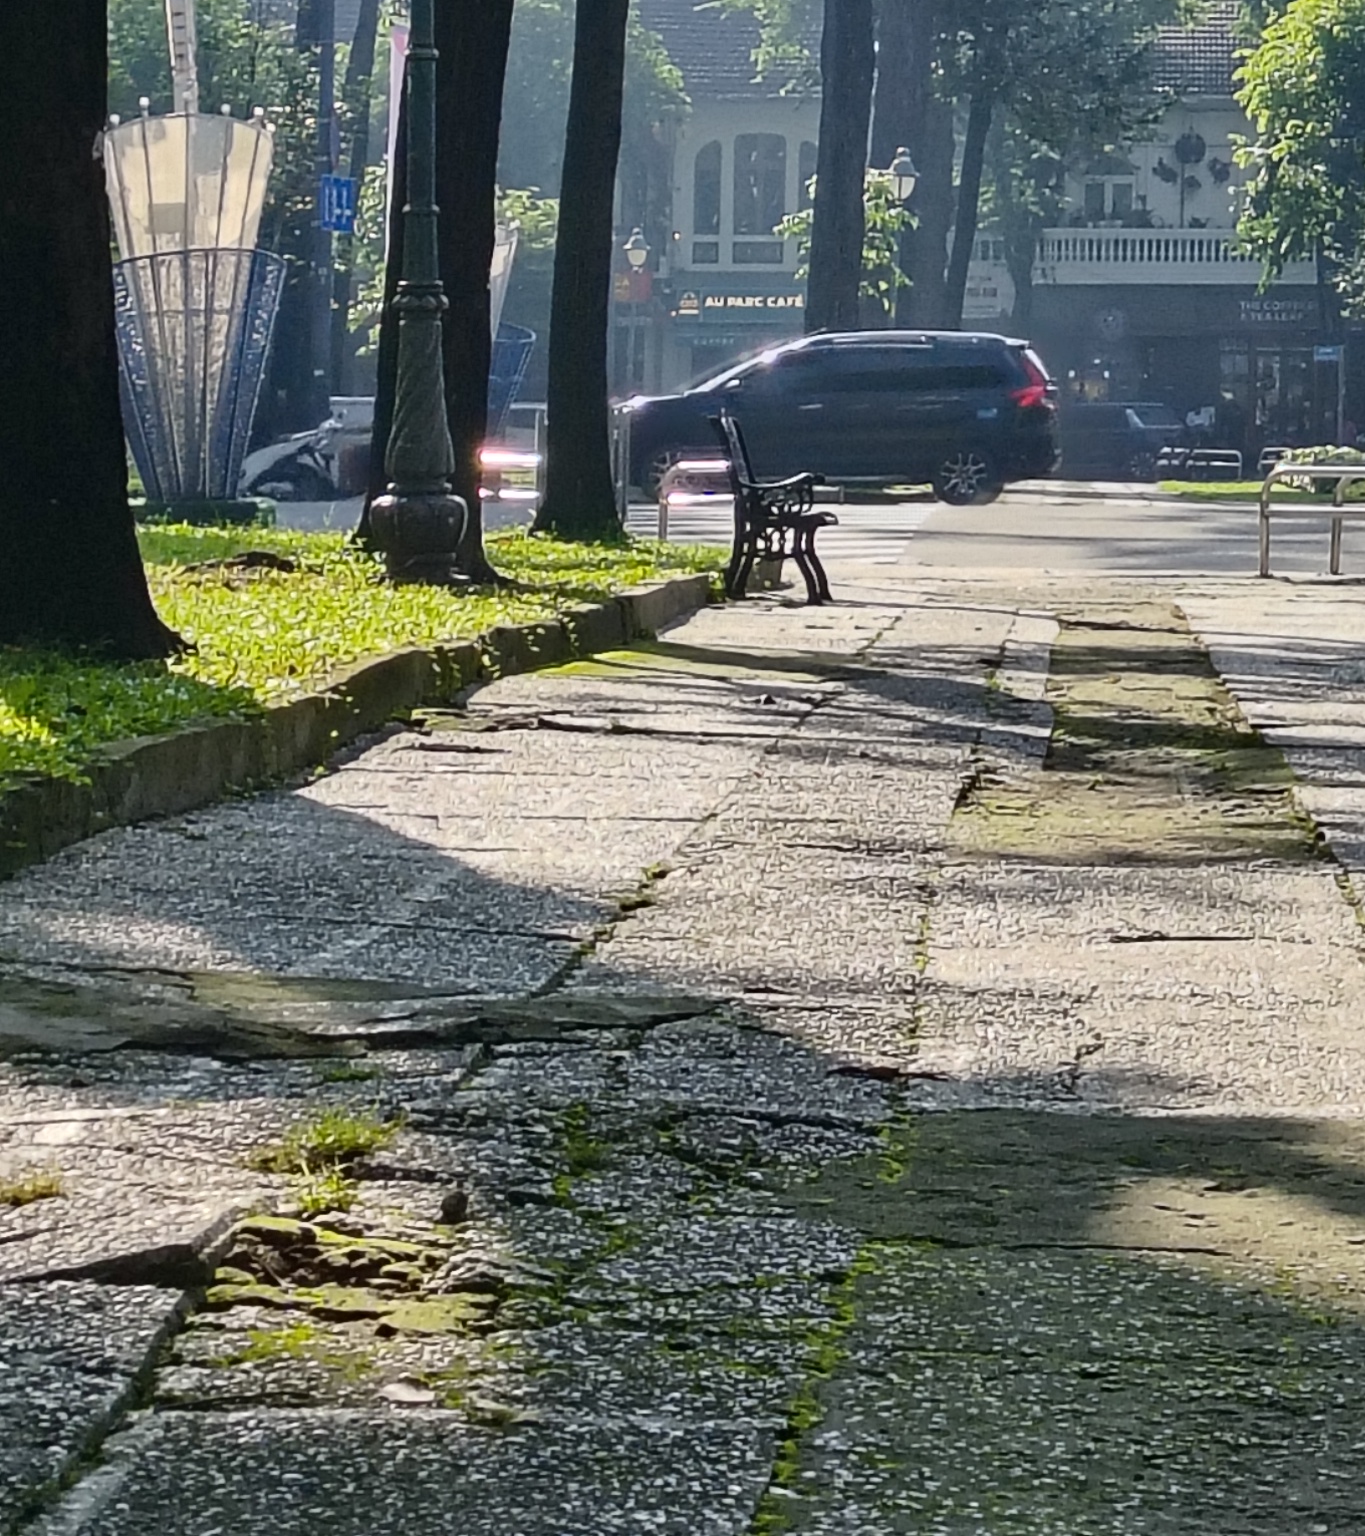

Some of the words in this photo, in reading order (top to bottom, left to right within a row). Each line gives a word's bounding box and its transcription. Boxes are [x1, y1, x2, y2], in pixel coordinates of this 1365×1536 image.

[704, 296, 724, 307] AU
[727, 296, 764, 307] PARC
[766, 293, 803, 307] CAFÉ
